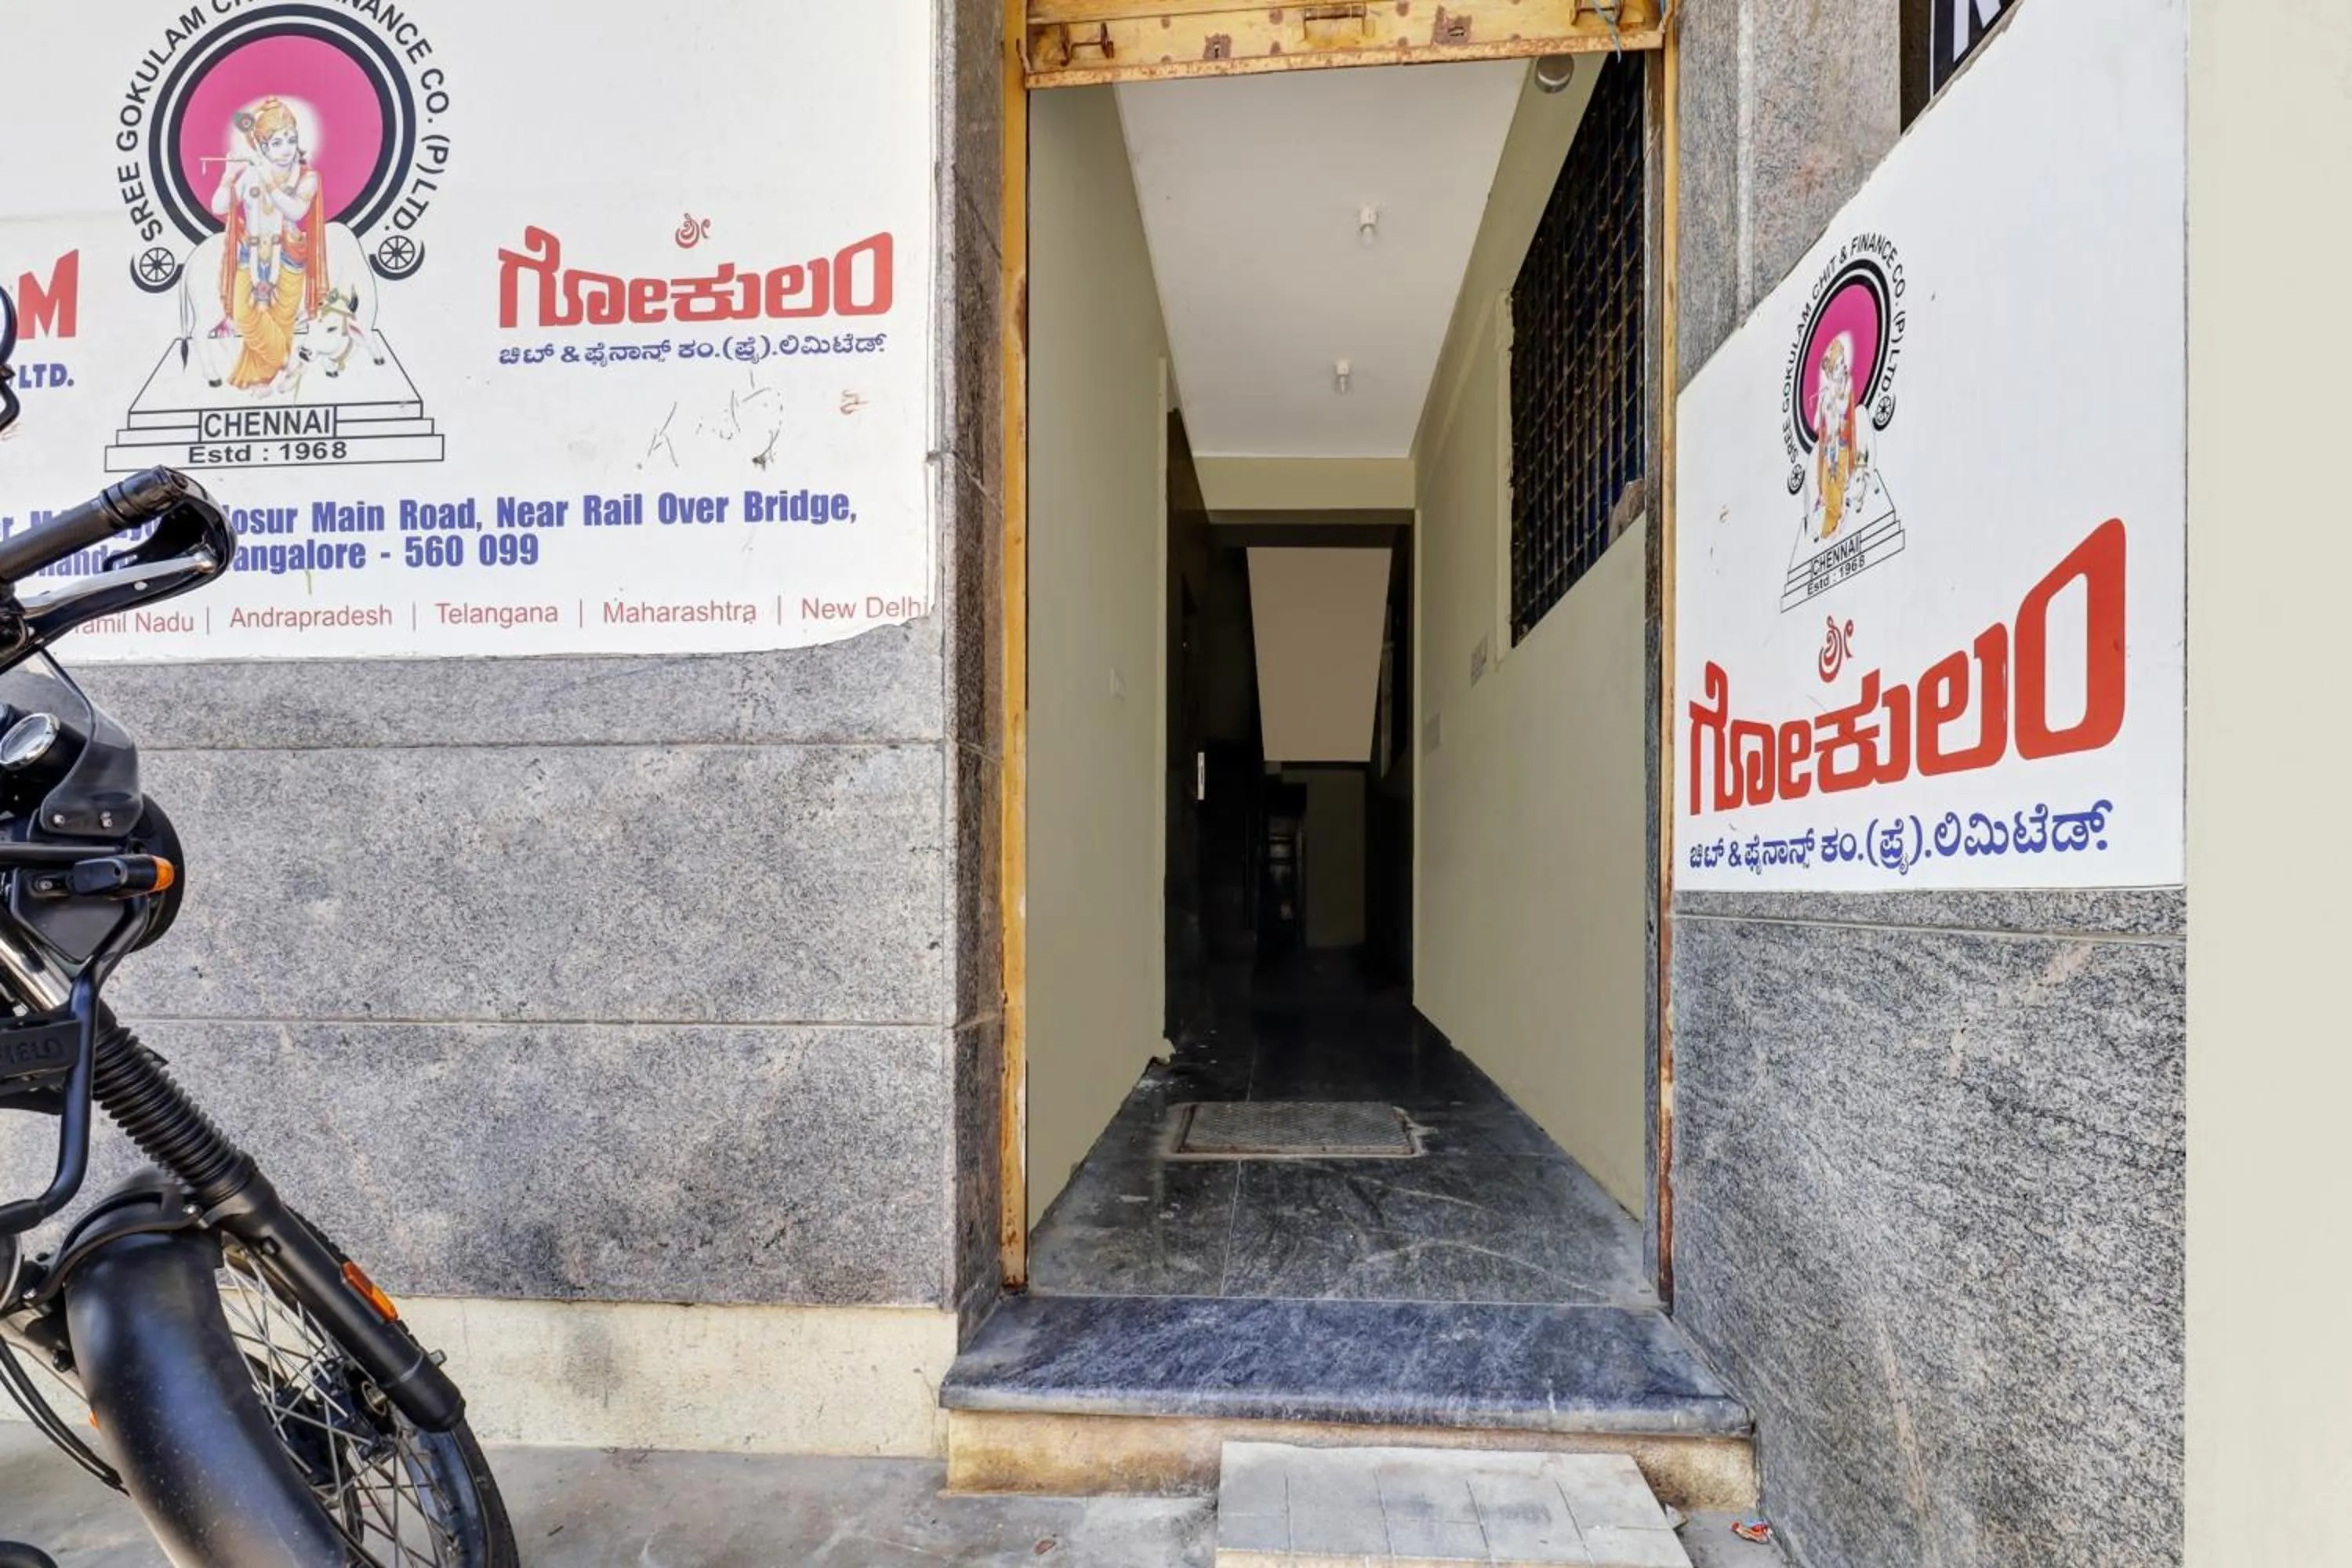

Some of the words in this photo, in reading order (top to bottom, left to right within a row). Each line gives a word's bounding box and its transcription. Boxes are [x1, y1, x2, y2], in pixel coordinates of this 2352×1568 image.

[116, 5, 207, 151] GOKULAM
[421, 68, 449, 123] CO.
[118, 162, 163, 242] SREE
[1839, 245, 1848, 264] &
[1850, 233, 1898, 270] FINANCE
[498, 224, 894, 328] ಗೋಕುಲಂ
[1813, 255, 1836, 300] CHIT
[19, 363, 74, 389] LTD.
[1782, 303, 1812, 413] GOKULAM
[204, 408, 330, 437] CHENNAI
[1782, 417, 1799, 464] SREE
[188, 445, 252, 464] Estd
[278, 441, 348, 461] 1968
[222, 504, 298, 535] osur
[311, 501, 385, 533] Main
[399, 499, 483, 532] Road,
[496, 495, 569, 528] Near
[583, 493, 643, 526] Rail
[658, 492, 729, 524] Over
[743, 489, 857, 524] Bridge,
[232, 539, 367, 575] angalore
[405, 535, 463, 568] 560
[478, 533, 539, 566] 099
[1812, 535, 1860, 575] CHENNAI
[1807, 574, 1829, 596] Estd
[1839, 554, 1865, 578] 1968
[135, 611, 194, 633] Nadu
[230, 604, 391, 632] Andrapradesh
[435, 603, 558, 628] Telangana
[603, 600, 757, 624] Maharashtra
[802, 597, 856, 620] New
[1689, 517, 2126, 816] ಗೋಕುಲಂ
